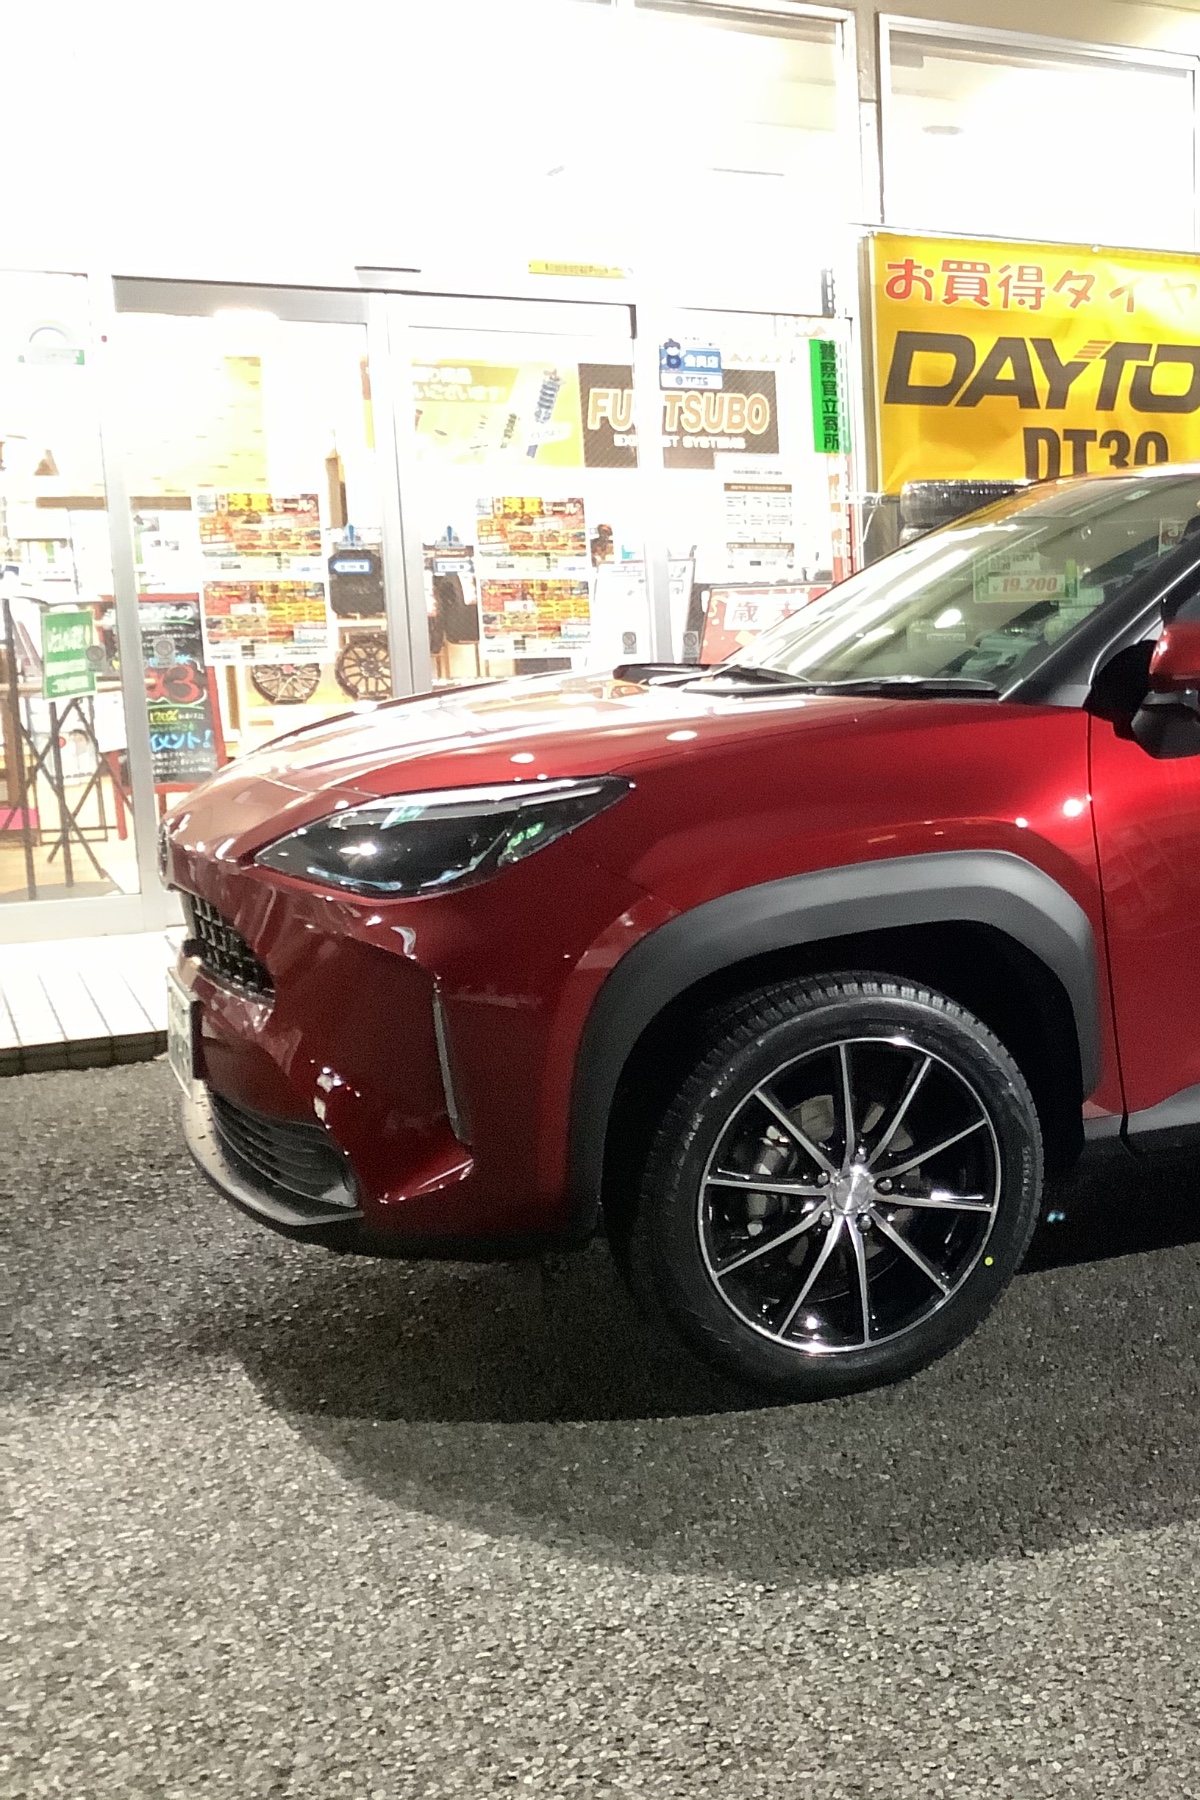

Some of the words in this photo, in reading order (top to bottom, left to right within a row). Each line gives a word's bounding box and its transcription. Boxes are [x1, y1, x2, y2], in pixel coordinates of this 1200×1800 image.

[587, 388, 770, 435] FUTSUBO
[819, 340, 840, 450] 警察官立寄所
[1023, 427, 1169, 480] DT30
